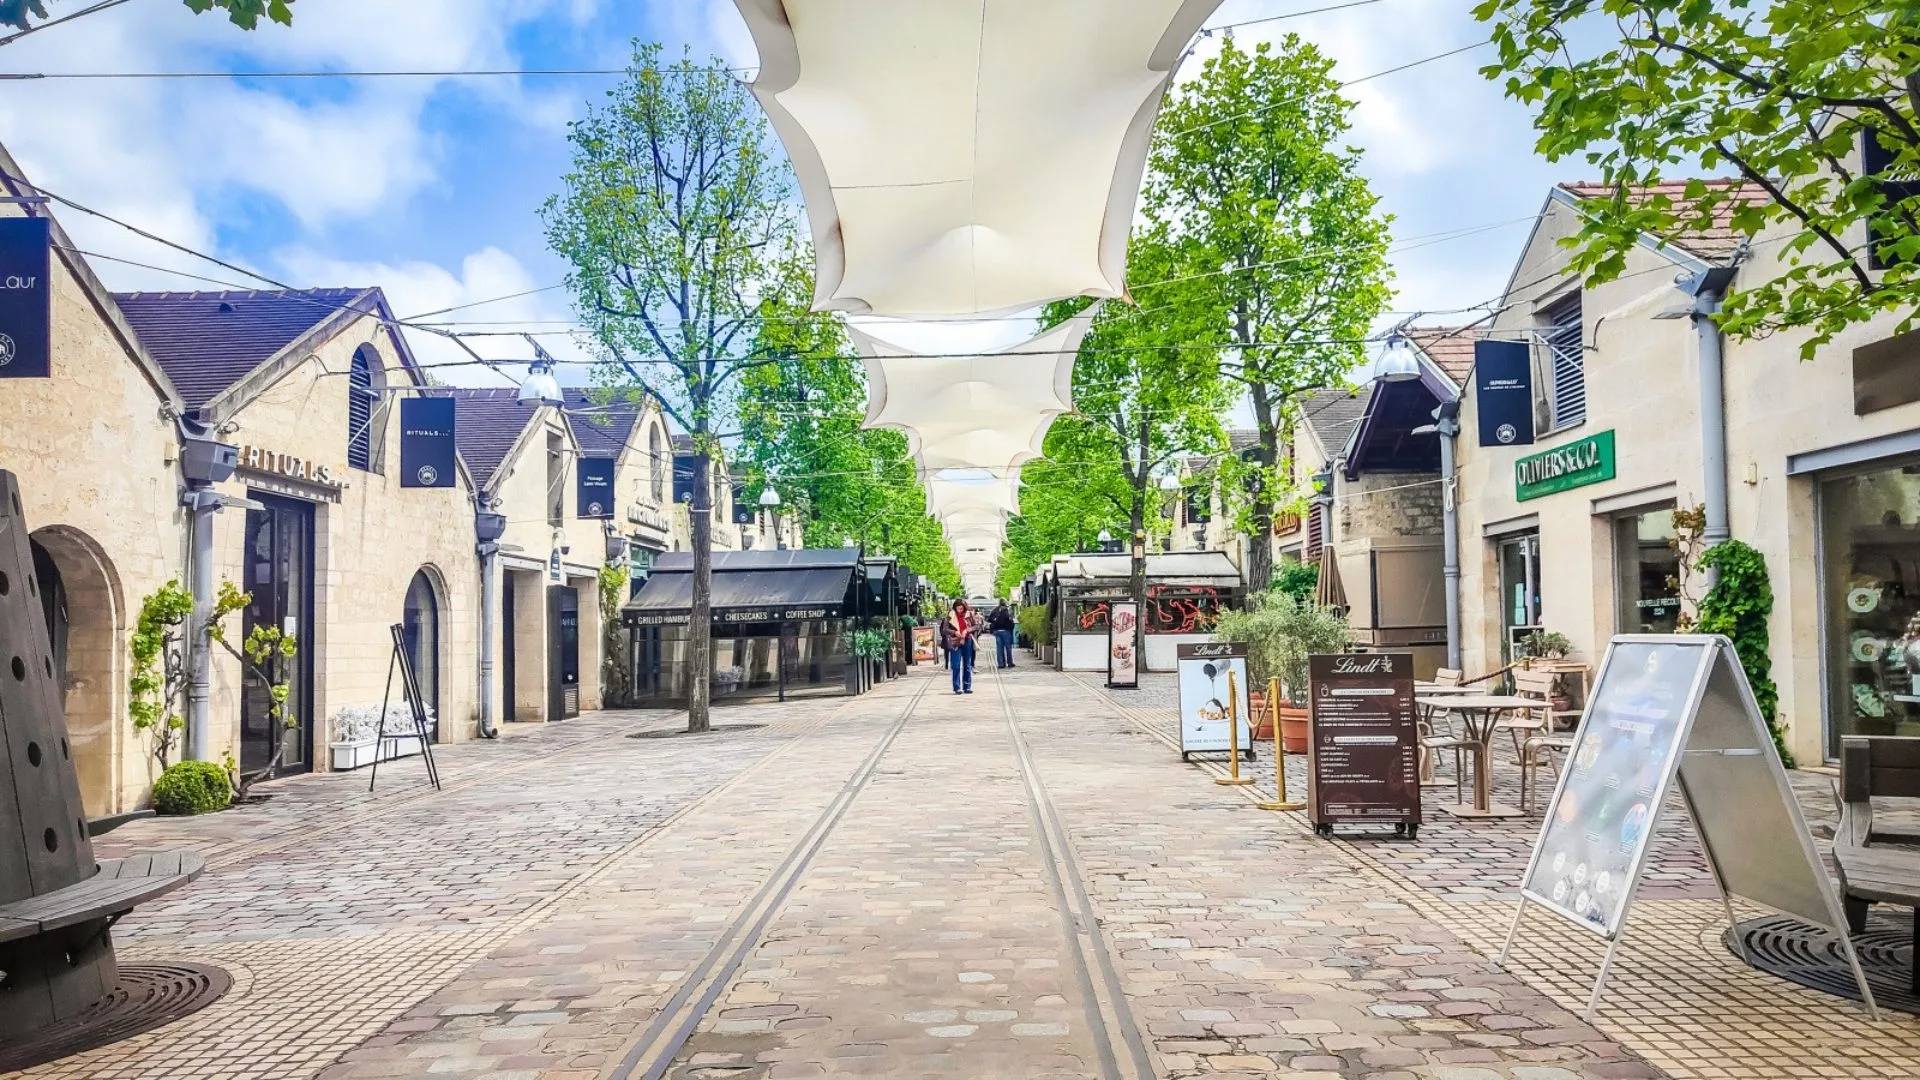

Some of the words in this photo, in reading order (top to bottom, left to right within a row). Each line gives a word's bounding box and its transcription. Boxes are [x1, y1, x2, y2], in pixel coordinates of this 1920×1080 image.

[638, 616, 662, 625] GRILLED
[664, 615, 691, 624] HAMBUR
[725, 611, 768, 621] CHEESECAKES
[785, 610, 808, 619] COFFEE
[808, 609, 826, 618] SHOP
[1193, 644, 1224, 656] Lindt
[1330, 657, 1380, 673] Lindt
